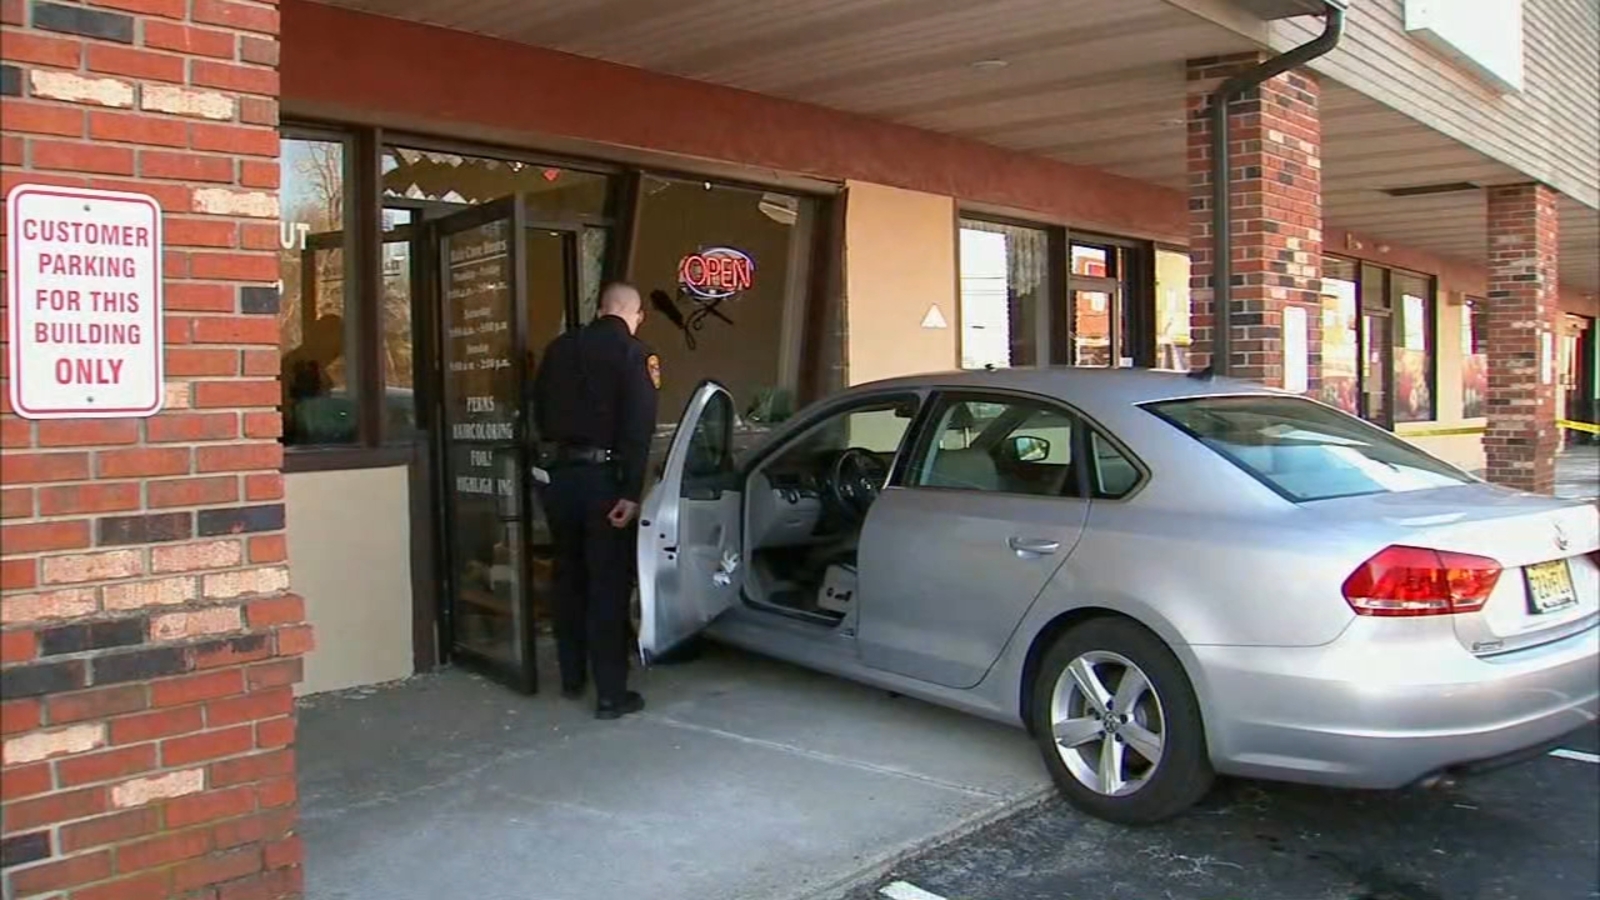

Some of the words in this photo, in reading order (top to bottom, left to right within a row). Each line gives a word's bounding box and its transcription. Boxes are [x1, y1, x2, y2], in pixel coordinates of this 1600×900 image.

[23, 218, 149, 247] CUSTOMER
[38, 253, 136, 278] PARKING
[684, 255, 751, 288] OPEN
[35, 289, 81, 311] FOR
[90, 291, 139, 313] THIS
[34, 322, 141, 345] BUILDING
[55, 358, 124, 385] ONLY
